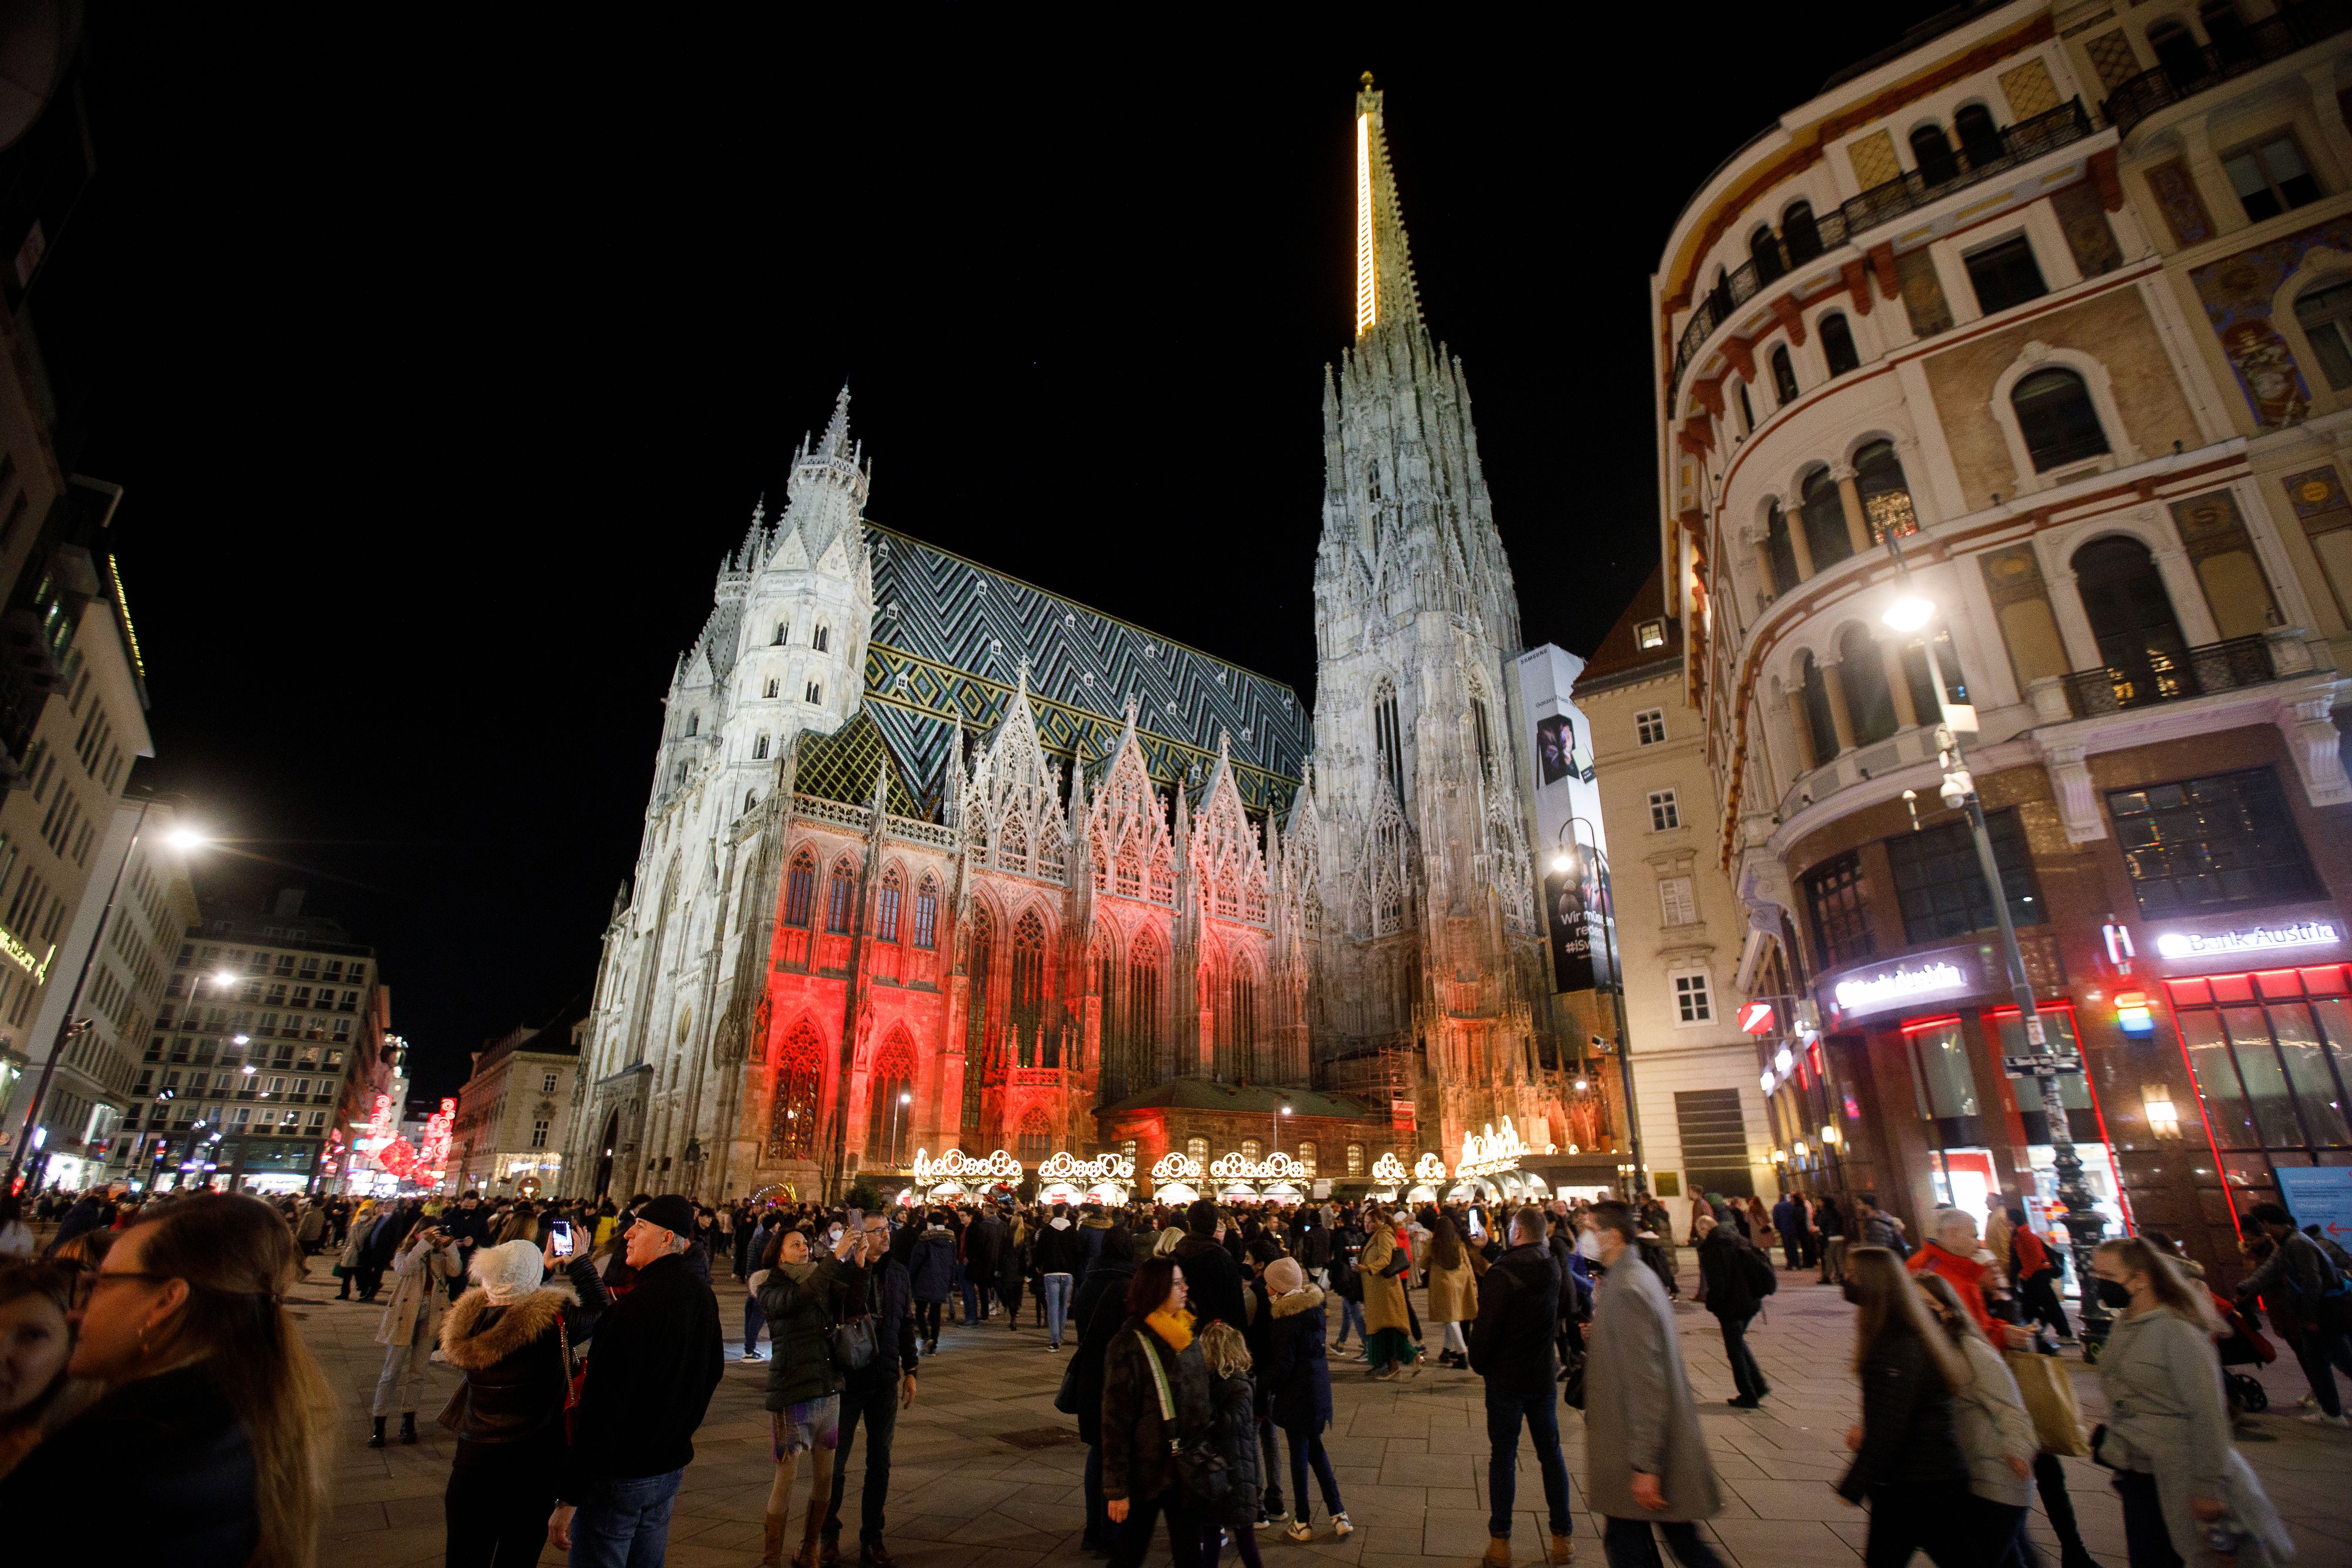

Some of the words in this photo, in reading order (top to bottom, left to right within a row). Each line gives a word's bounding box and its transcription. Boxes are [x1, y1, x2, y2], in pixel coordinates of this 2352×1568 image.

[1521, 648, 1548, 664] SAMSUNG
[1561, 910, 1581, 925] Wir
[1576, 924, 1604, 938] reden
[2188, 931, 2249, 951] Bank
[2254, 922, 2336, 945] Austria
